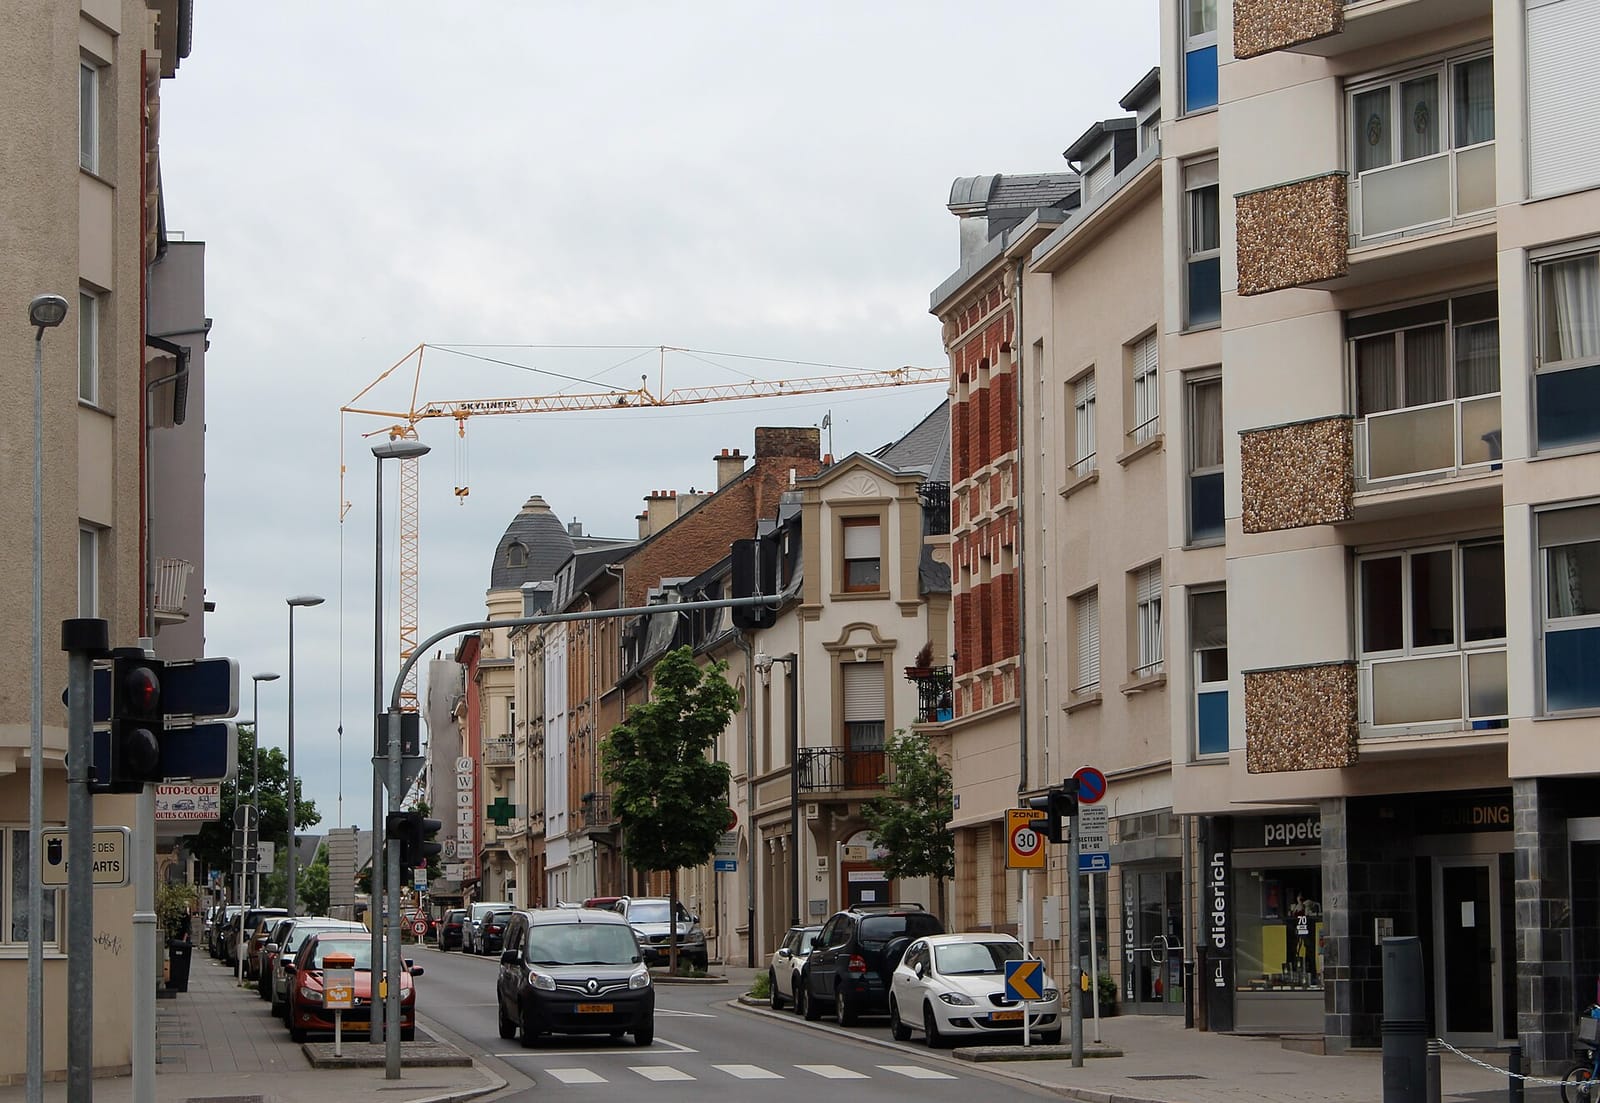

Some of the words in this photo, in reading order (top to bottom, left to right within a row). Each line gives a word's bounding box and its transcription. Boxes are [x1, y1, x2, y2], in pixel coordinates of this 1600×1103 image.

[461, 401, 518, 410] SKYLINERS
[1017, 833, 1035, 848] 30
[98, 843, 115, 853] DES
[1211, 852, 1226, 948] diderich
